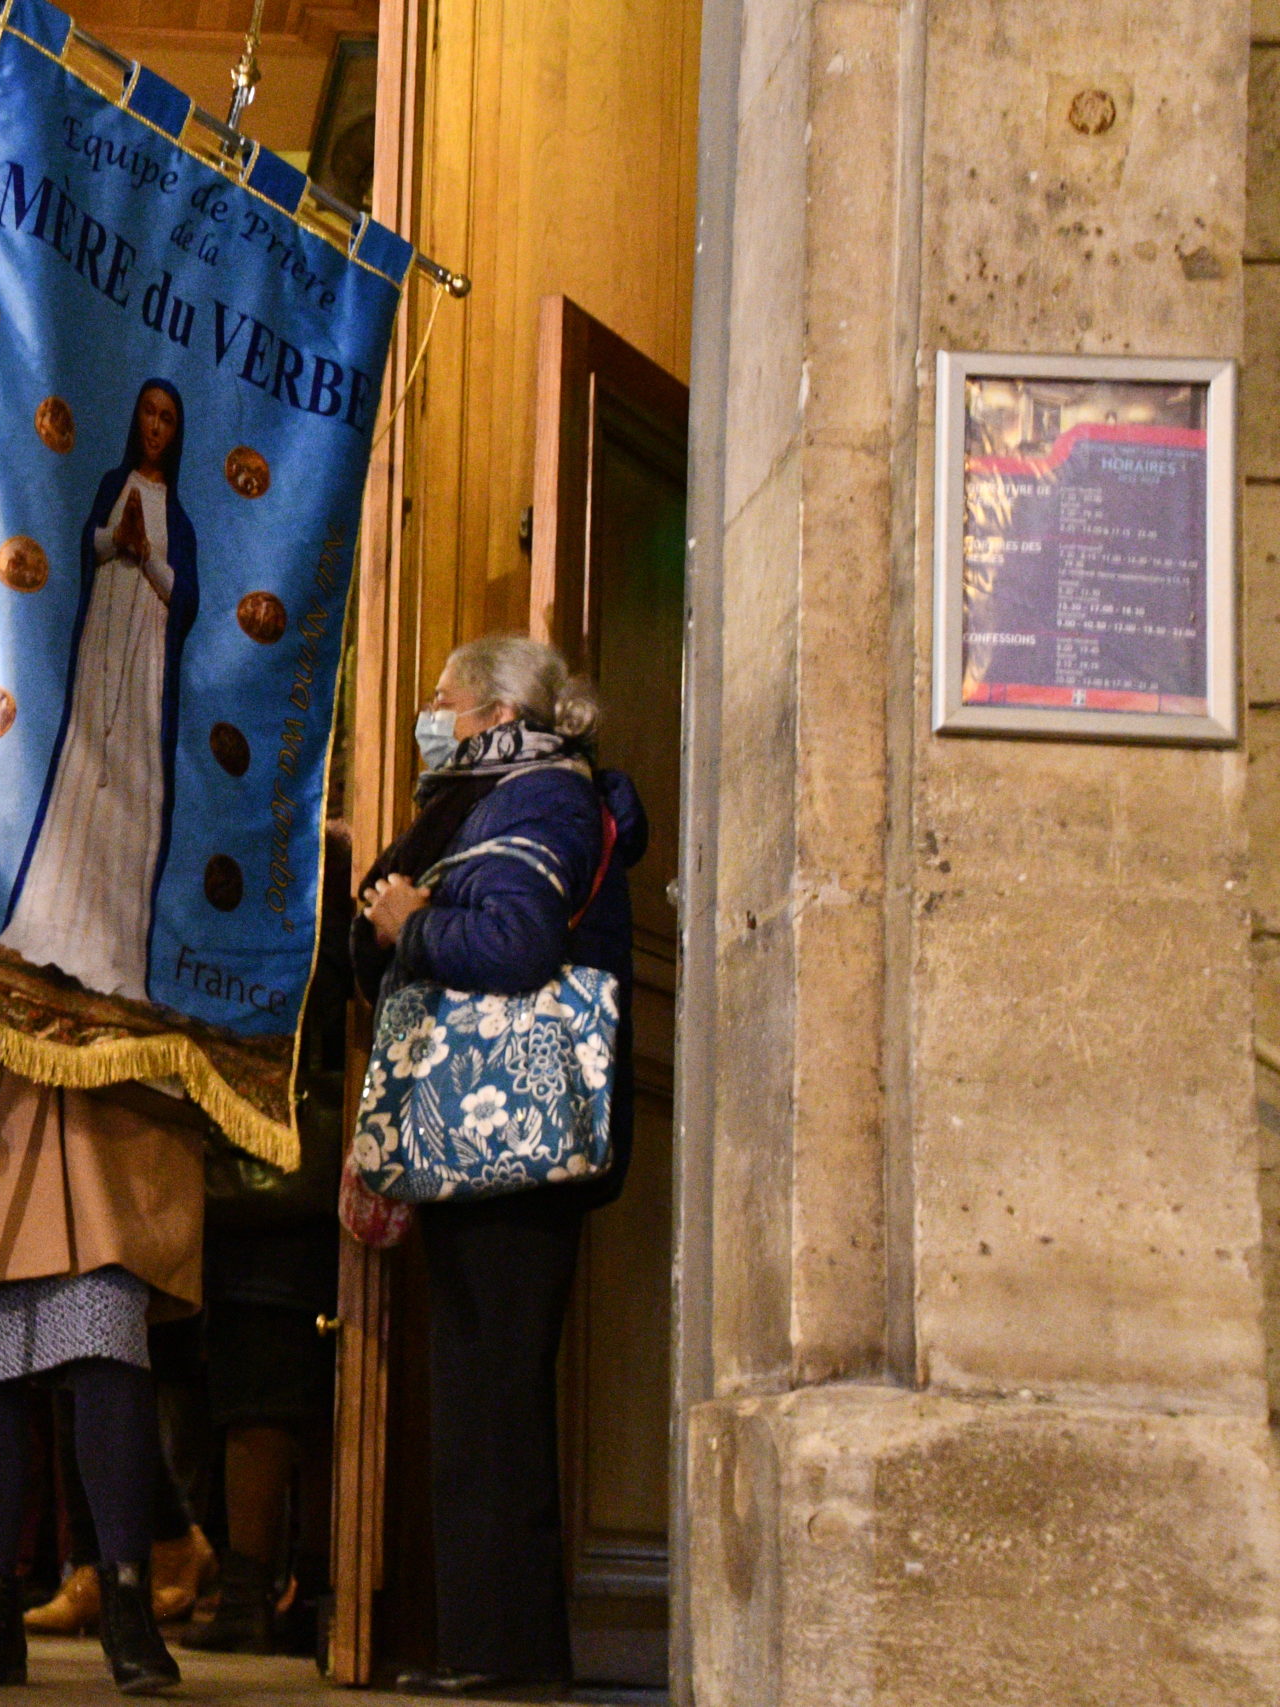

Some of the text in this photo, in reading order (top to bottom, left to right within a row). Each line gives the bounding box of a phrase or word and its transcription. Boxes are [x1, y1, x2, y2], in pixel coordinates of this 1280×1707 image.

[170, 219, 218, 267] de la
[191, 181, 229, 223] de
[244, 209, 337, 313] Prière
[142, 270, 195, 348] du
[213, 299, 373, 433] VERBE
[1101, 457, 1177, 476] HORAIRES
[964, 632, 1037, 646] CONFESSIONS
[279, 718, 305, 776] wa
[174, 945, 287, 1016] France
